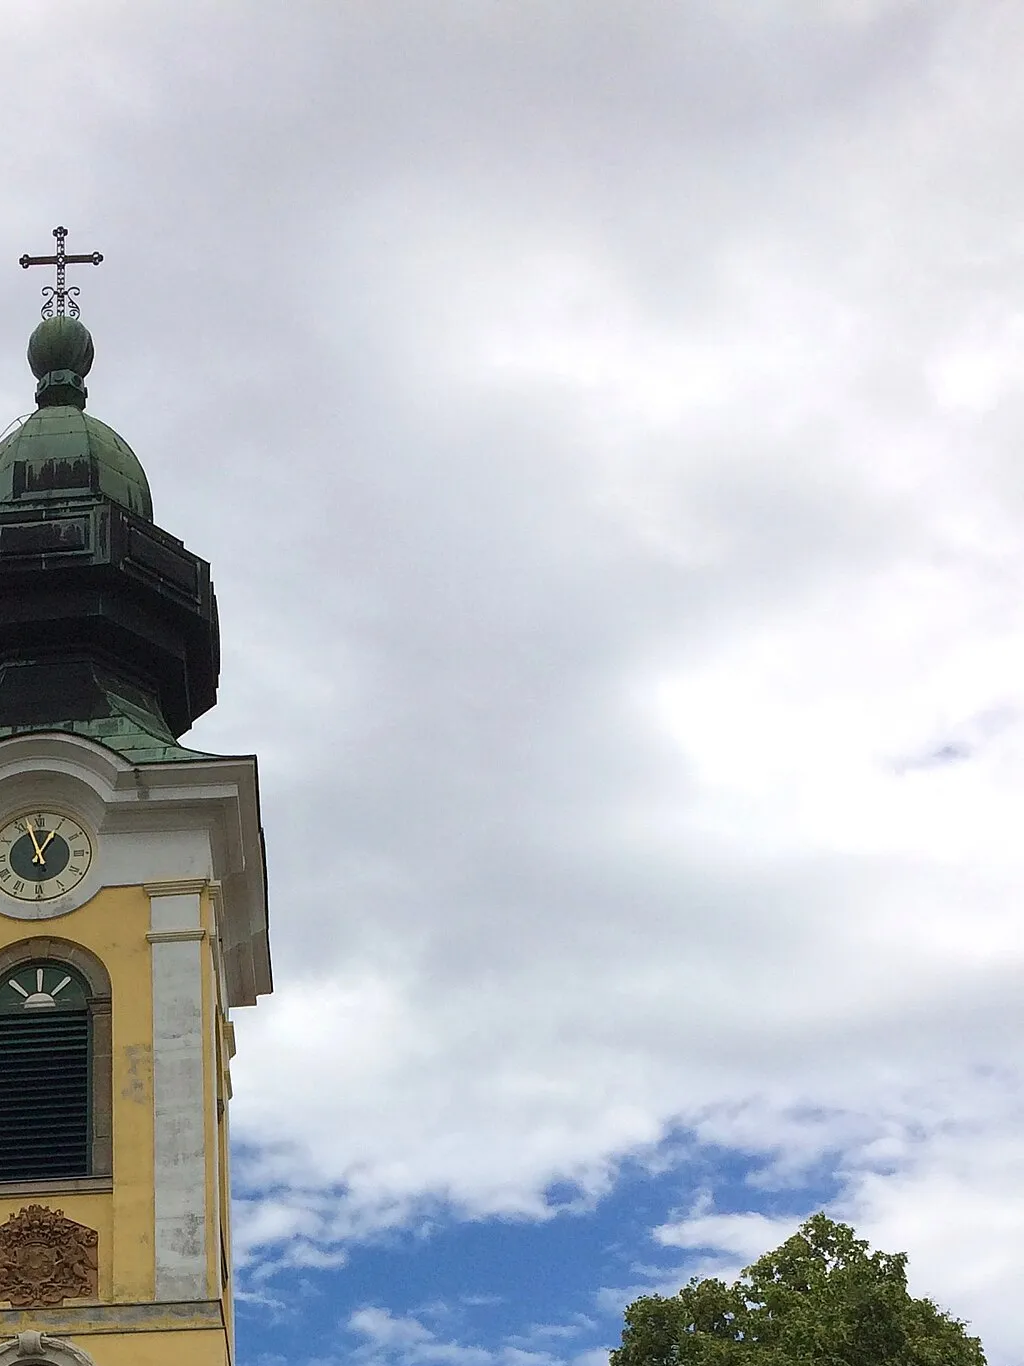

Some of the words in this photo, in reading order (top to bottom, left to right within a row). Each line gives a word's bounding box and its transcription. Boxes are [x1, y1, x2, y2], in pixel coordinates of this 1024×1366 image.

[35, 818, 45, 828] XII
[0, 836, 12, 846] X
[68, 833, 80, 842] II
[73, 849, 84, 857] III
[13, 880, 25, 892] VII
[35, 884, 43, 894] VI
